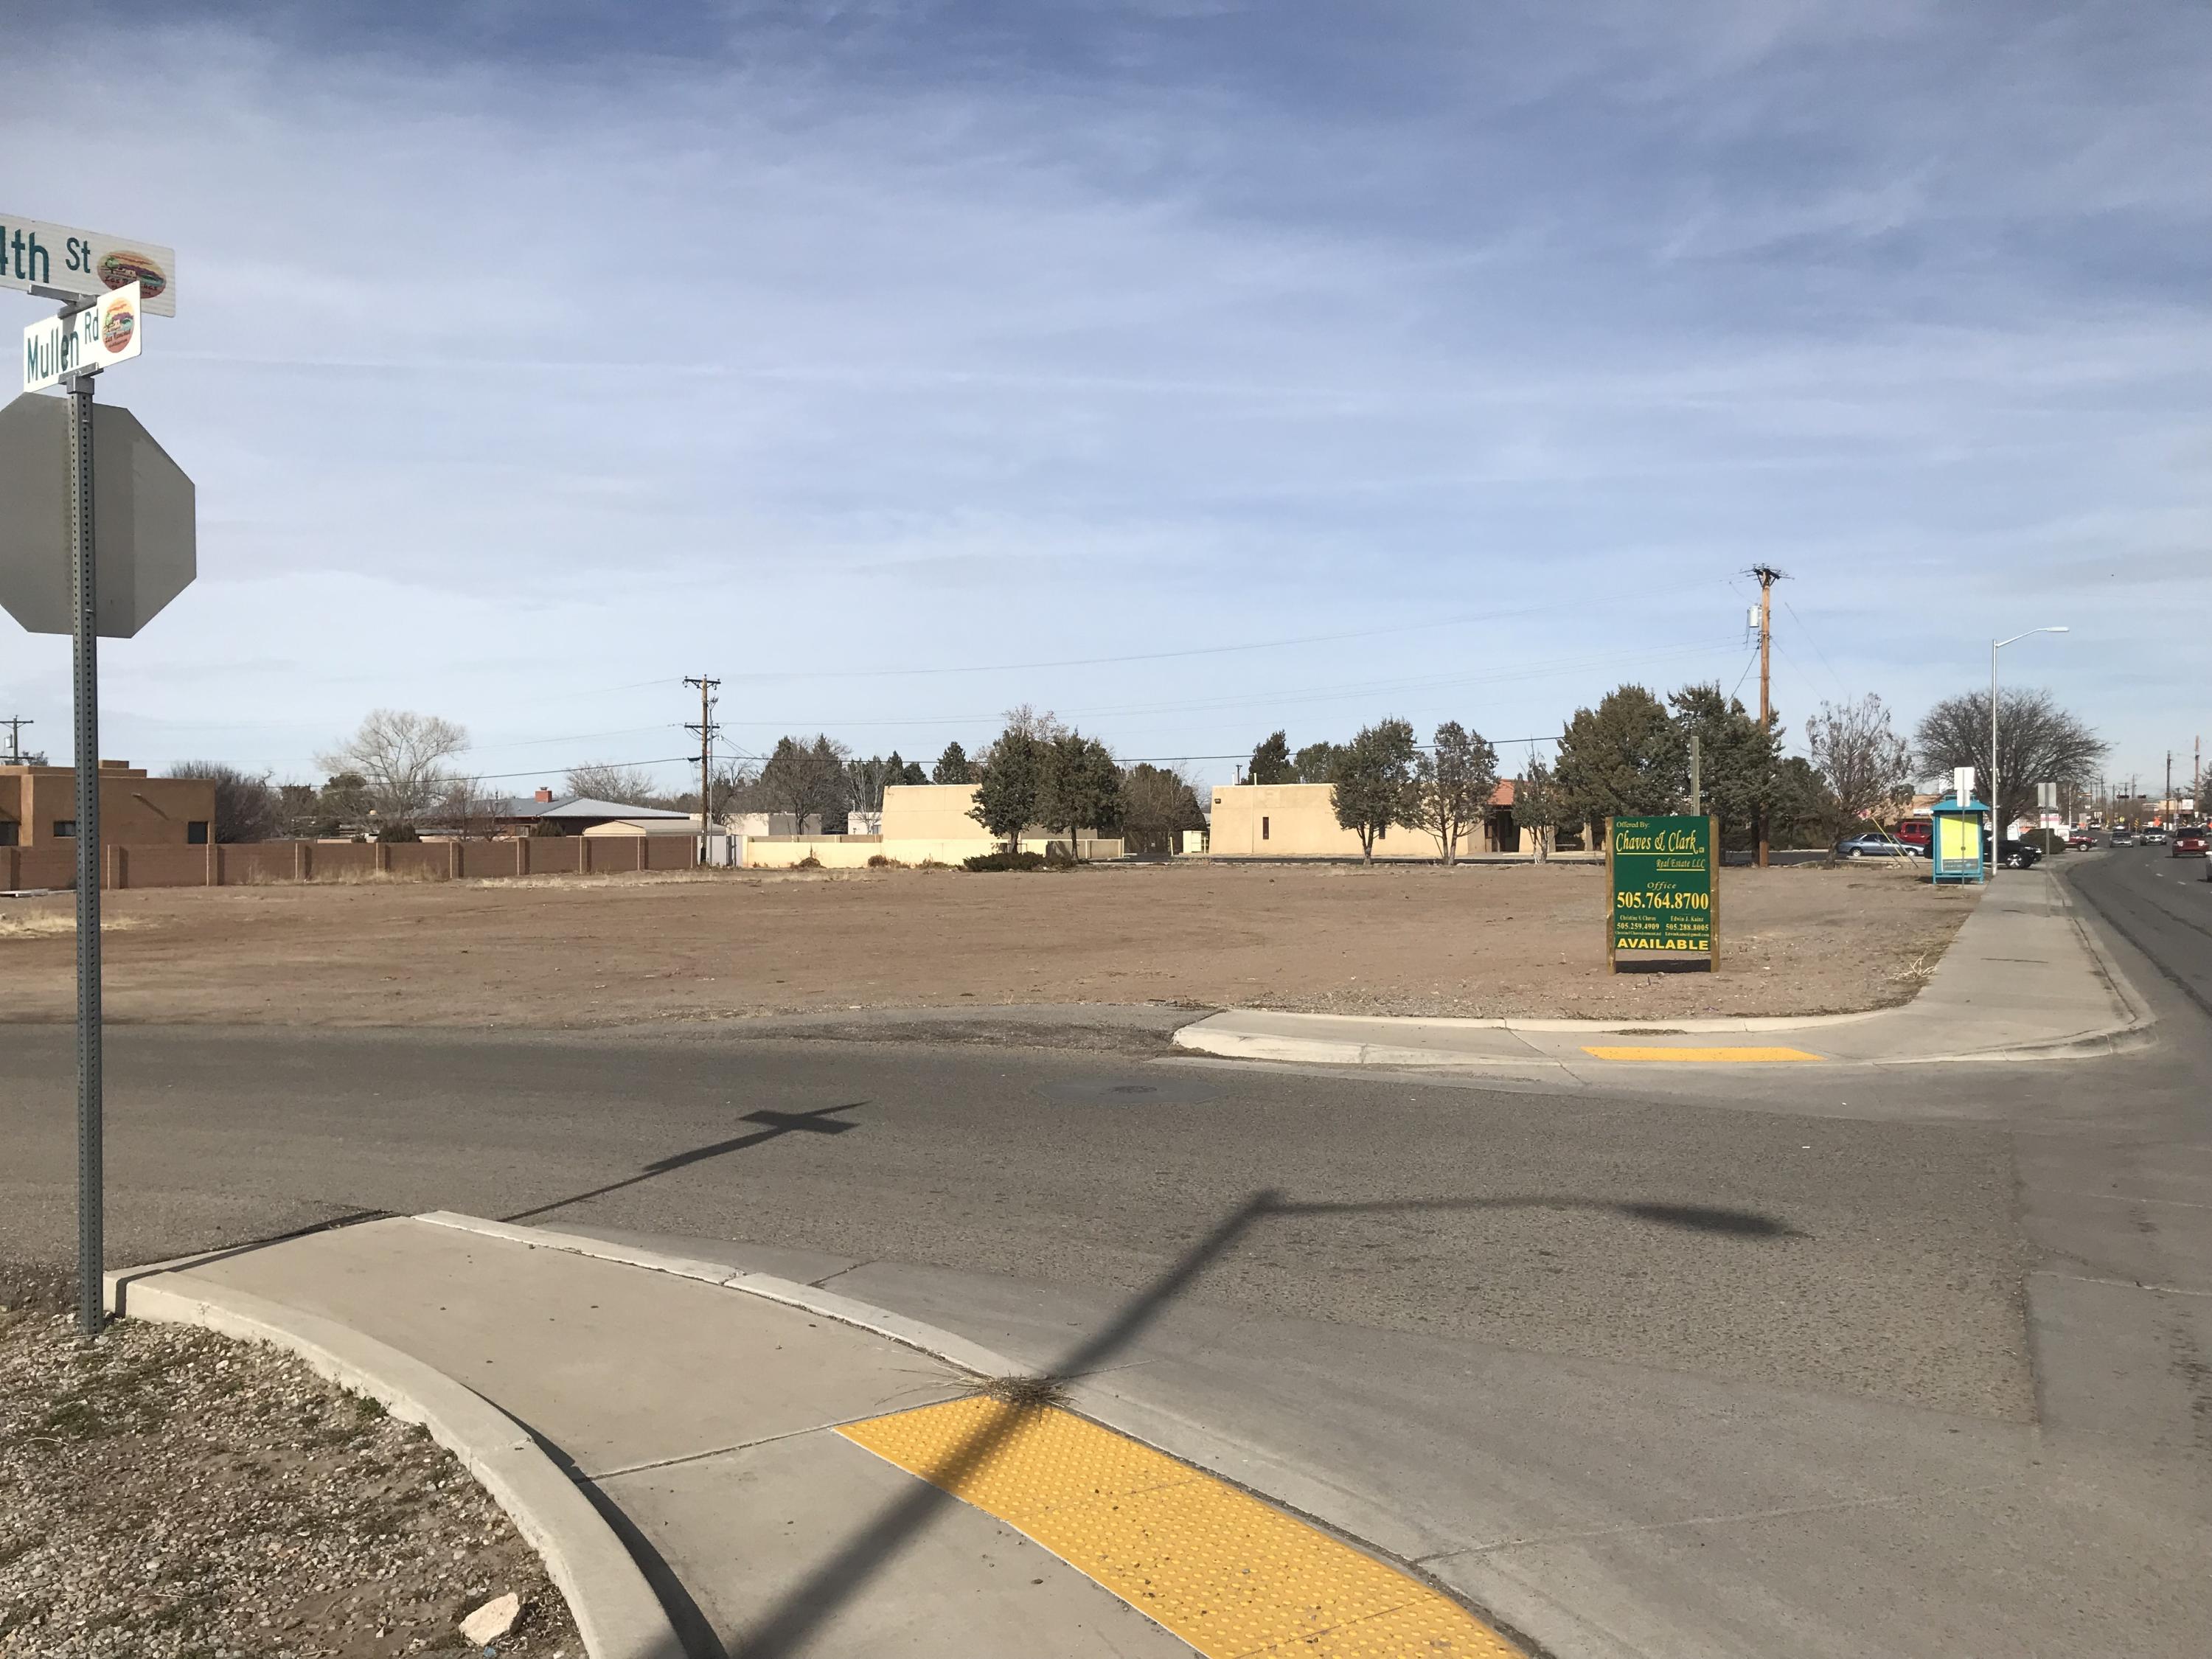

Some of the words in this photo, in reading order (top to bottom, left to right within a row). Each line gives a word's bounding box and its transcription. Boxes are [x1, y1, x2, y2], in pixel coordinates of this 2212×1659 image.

[66, 237, 91, 274] St
[27, 327, 79, 383] Mullen
[85, 308, 99, 344] Rd
[1616, 830, 1652, 852] Chaves
[1655, 830, 1666, 851] &
[1669, 830, 1698, 854] Clark
[1656, 858, 1669, 868] Real
[1671, 859, 1690, 868] Estate
[1691, 859, 1705, 868] LLC
[1647, 881, 1677, 891] Office
[1617, 891, 1708, 910] 505.764.8700
[1617, 938, 1708, 950] AVAILABLE
